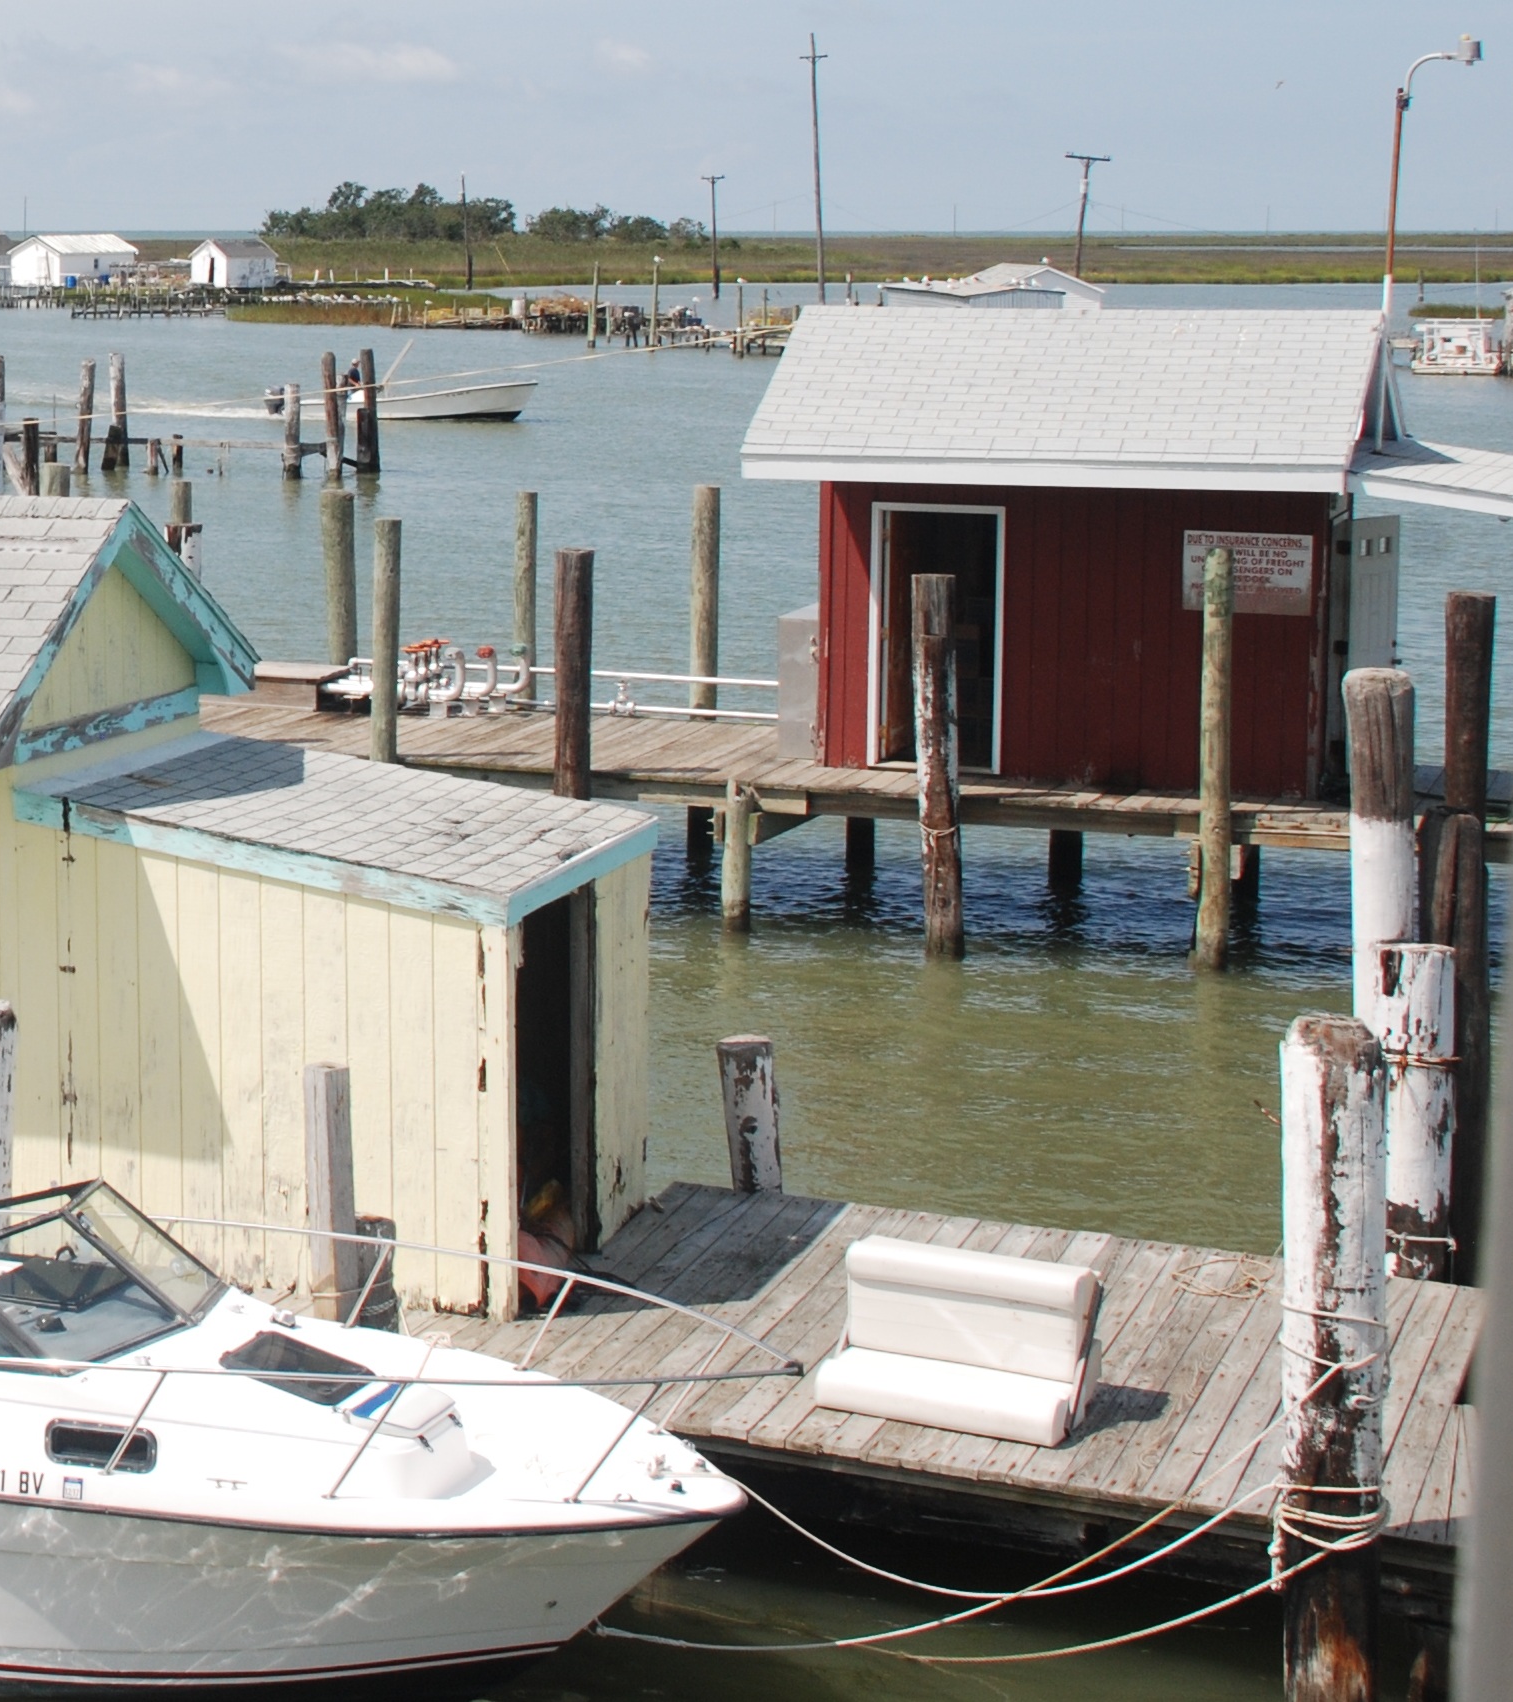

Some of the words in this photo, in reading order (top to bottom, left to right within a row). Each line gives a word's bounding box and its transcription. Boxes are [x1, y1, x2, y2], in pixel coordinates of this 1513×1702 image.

[1187, 534, 1203, 545] DUE
[1203, 535, 1215, 545] TO
[1216, 534, 1260, 547] INSURANCE
[1235, 549, 1256, 558] WILL
[1259, 550, 1270, 558] BE
[1272, 550, 1288, 559] NO
[1251, 557, 1263, 566] OF
[1265, 558, 1305, 568] FREIGHT
[1277, 567, 1293, 576] ON
[1244, 575, 1272, 584] DOCK
[19, 1471, 44, 1495] BV
